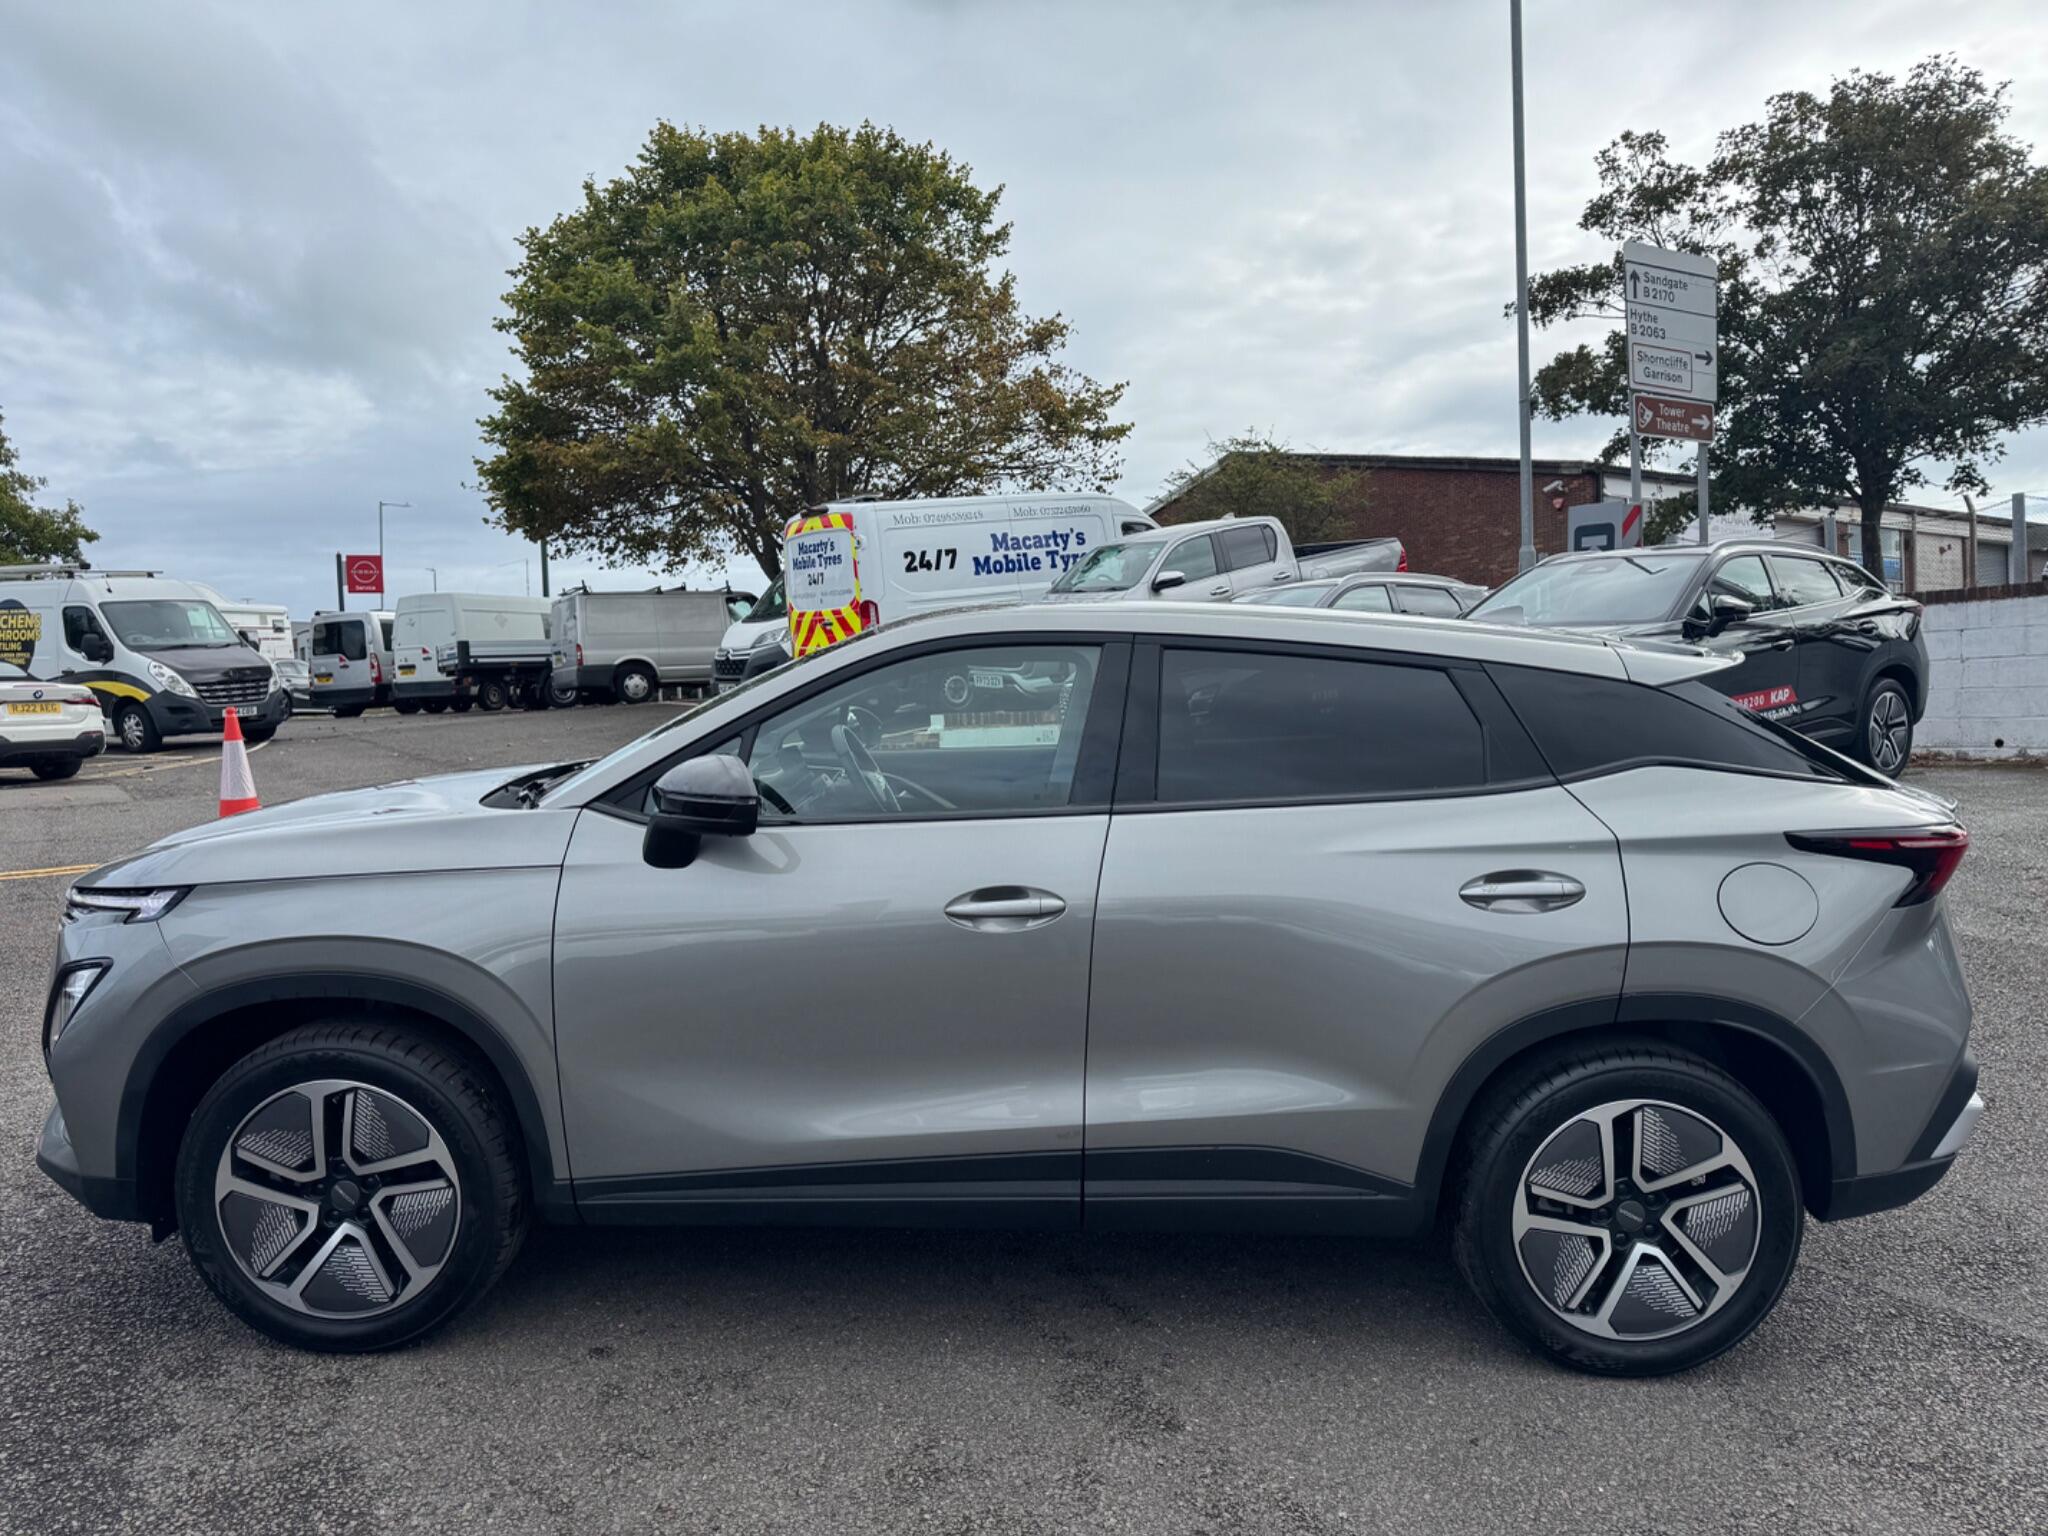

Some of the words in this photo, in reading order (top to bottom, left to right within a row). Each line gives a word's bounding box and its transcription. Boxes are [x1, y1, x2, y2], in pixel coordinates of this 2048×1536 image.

[1643, 271, 1689, 291] Sandgate
[1630, 308, 1658, 324] Hythe
[1637, 350, 1689, 369] Shorncliffe
[1643, 366, 1683, 384] Garrison
[1658, 403, 1686, 418] Tower
[1655, 417, 1690, 433] Theatre
[798, 538, 835, 556] Macarty's
[990, 527, 1086, 552] Macarty's
[792, 557, 817, 571] Mobile
[817, 553, 843, 570] Tyres
[903, 548, 957, 573] 24/7
[972, 553, 1042, 576] Mobile
[807, 572, 825, 586] 24/7
[0, 613, 42, 630] CHENS
[0, 629, 42, 642] HROOMS
[1770, 688, 1790, 705] KAP
